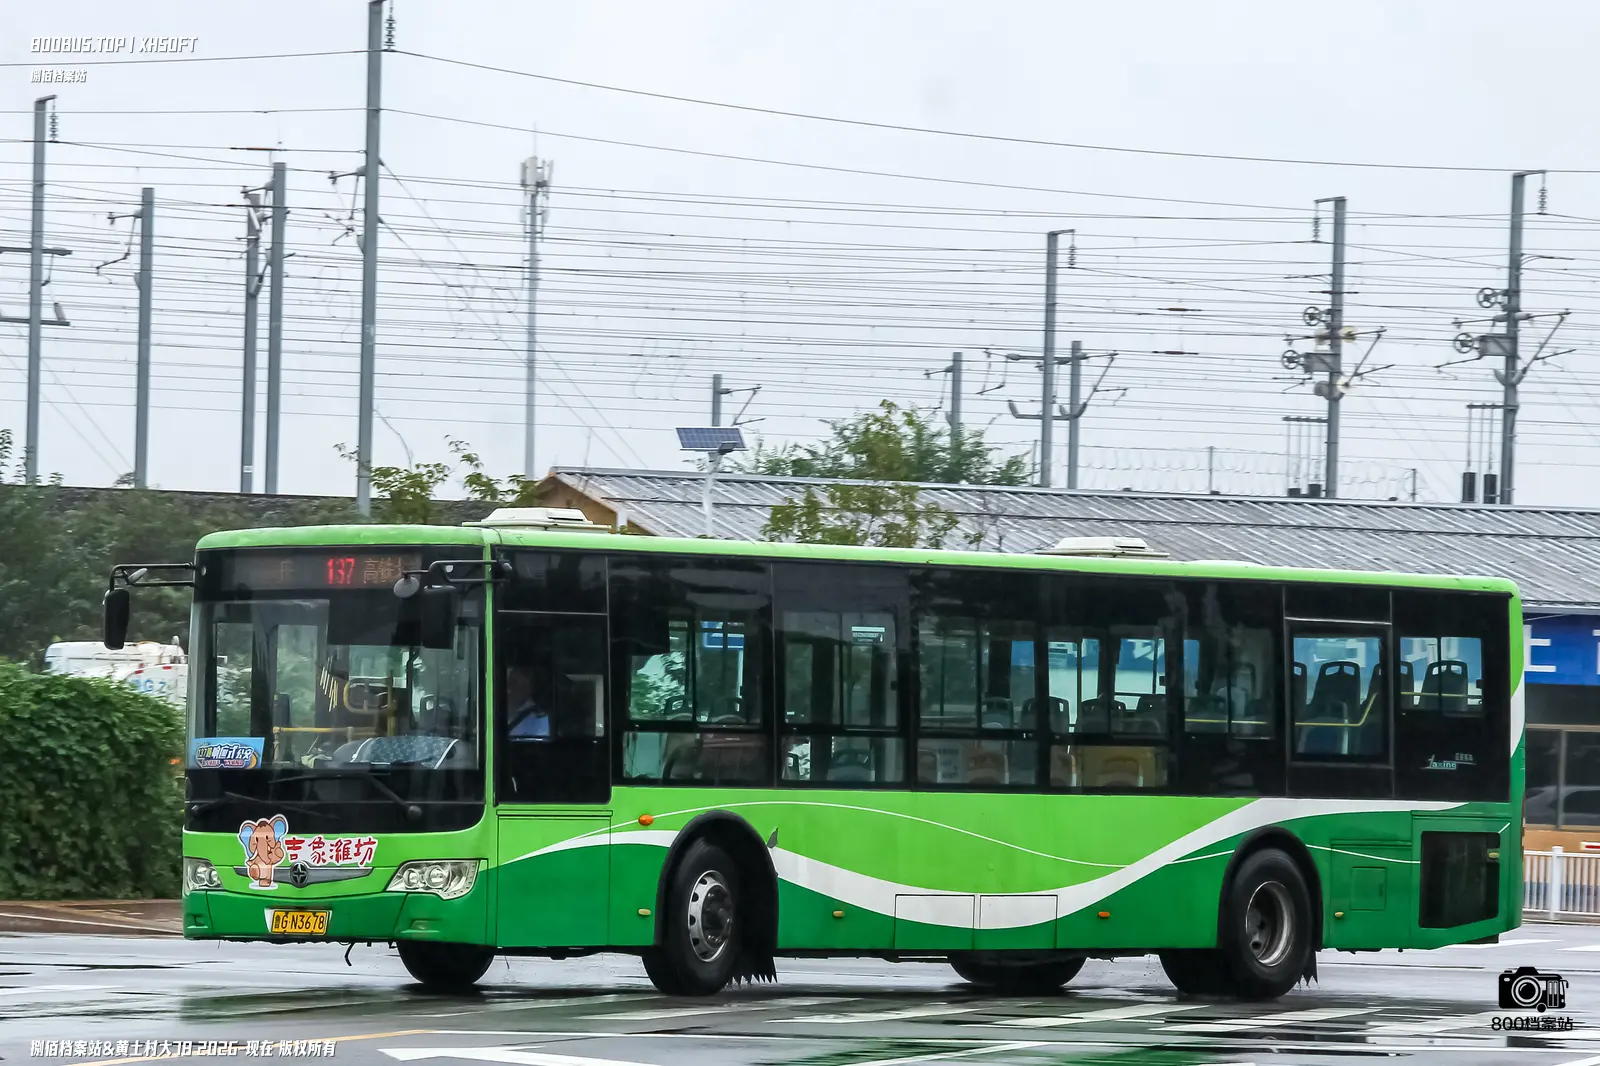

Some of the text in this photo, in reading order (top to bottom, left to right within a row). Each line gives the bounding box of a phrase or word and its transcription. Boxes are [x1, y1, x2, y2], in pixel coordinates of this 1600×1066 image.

[327, 557, 355, 584] 137
[284, 837, 377, 866] 吉象潍坊
